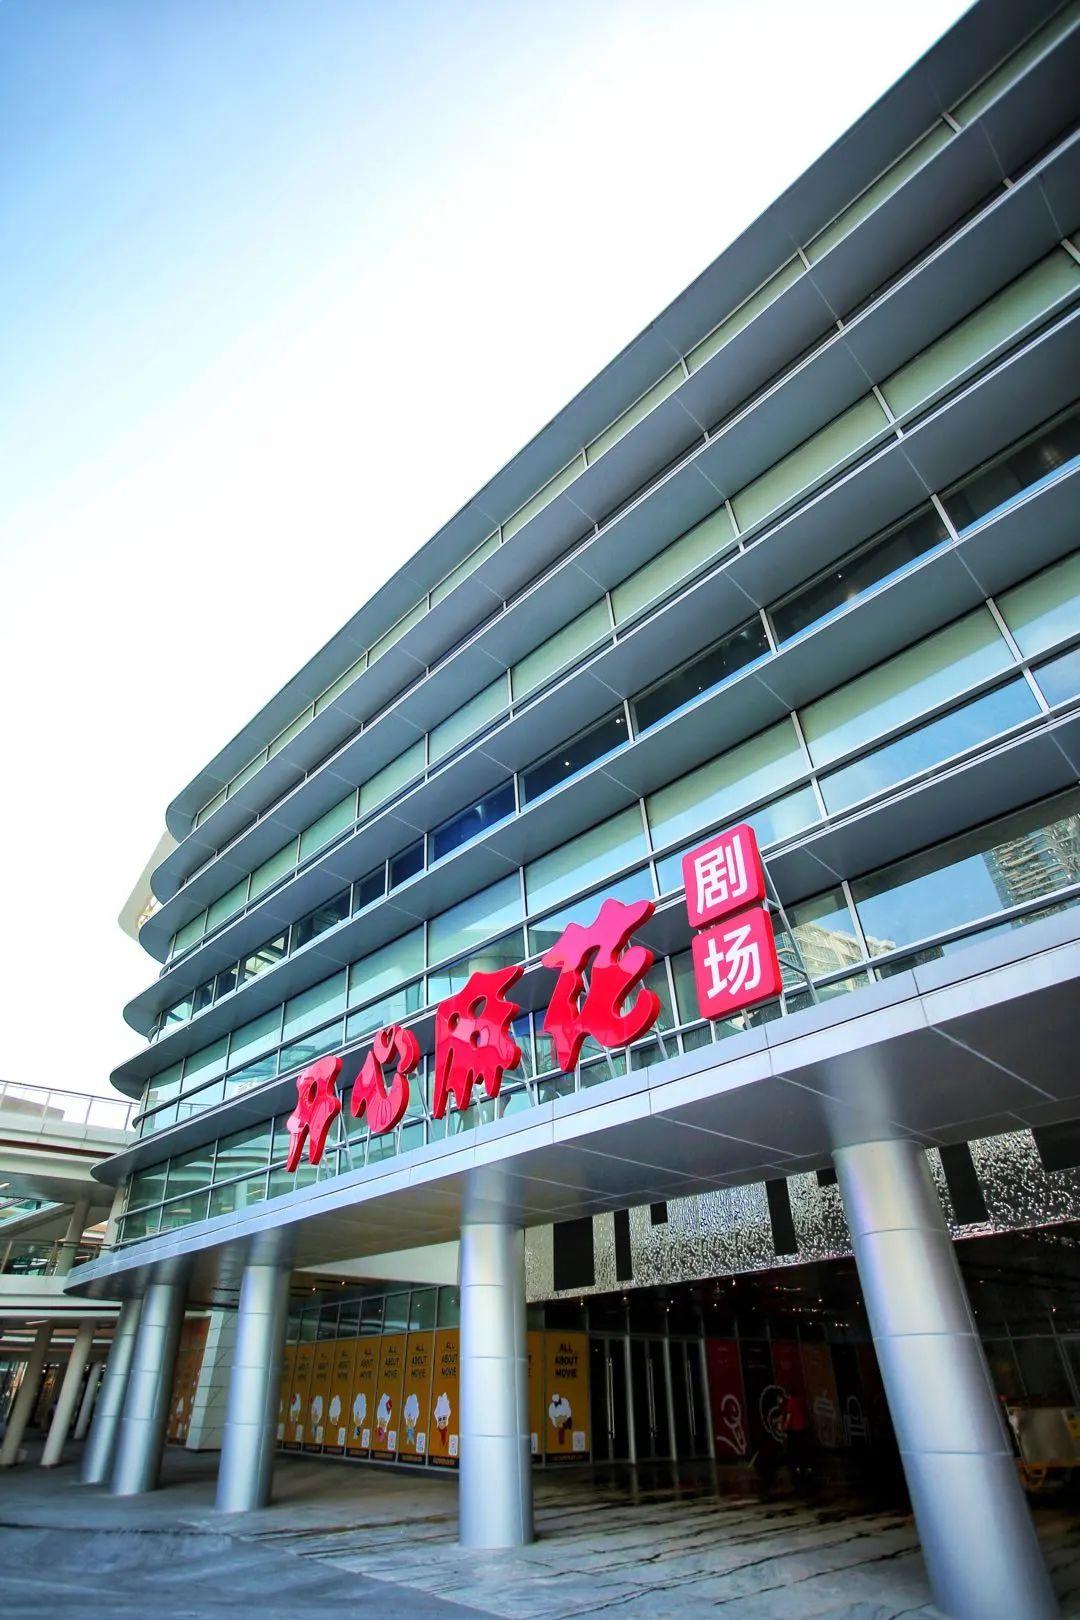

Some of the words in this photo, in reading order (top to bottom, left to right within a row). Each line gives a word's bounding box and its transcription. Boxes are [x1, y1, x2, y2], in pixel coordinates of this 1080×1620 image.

[692, 832, 764, 1002] 剧场
[286, 898, 661, 1173] 开心麻花
[554, 1355, 578, 1365] ABOUT
[554, 1367, 577, 1378] MOVIE
